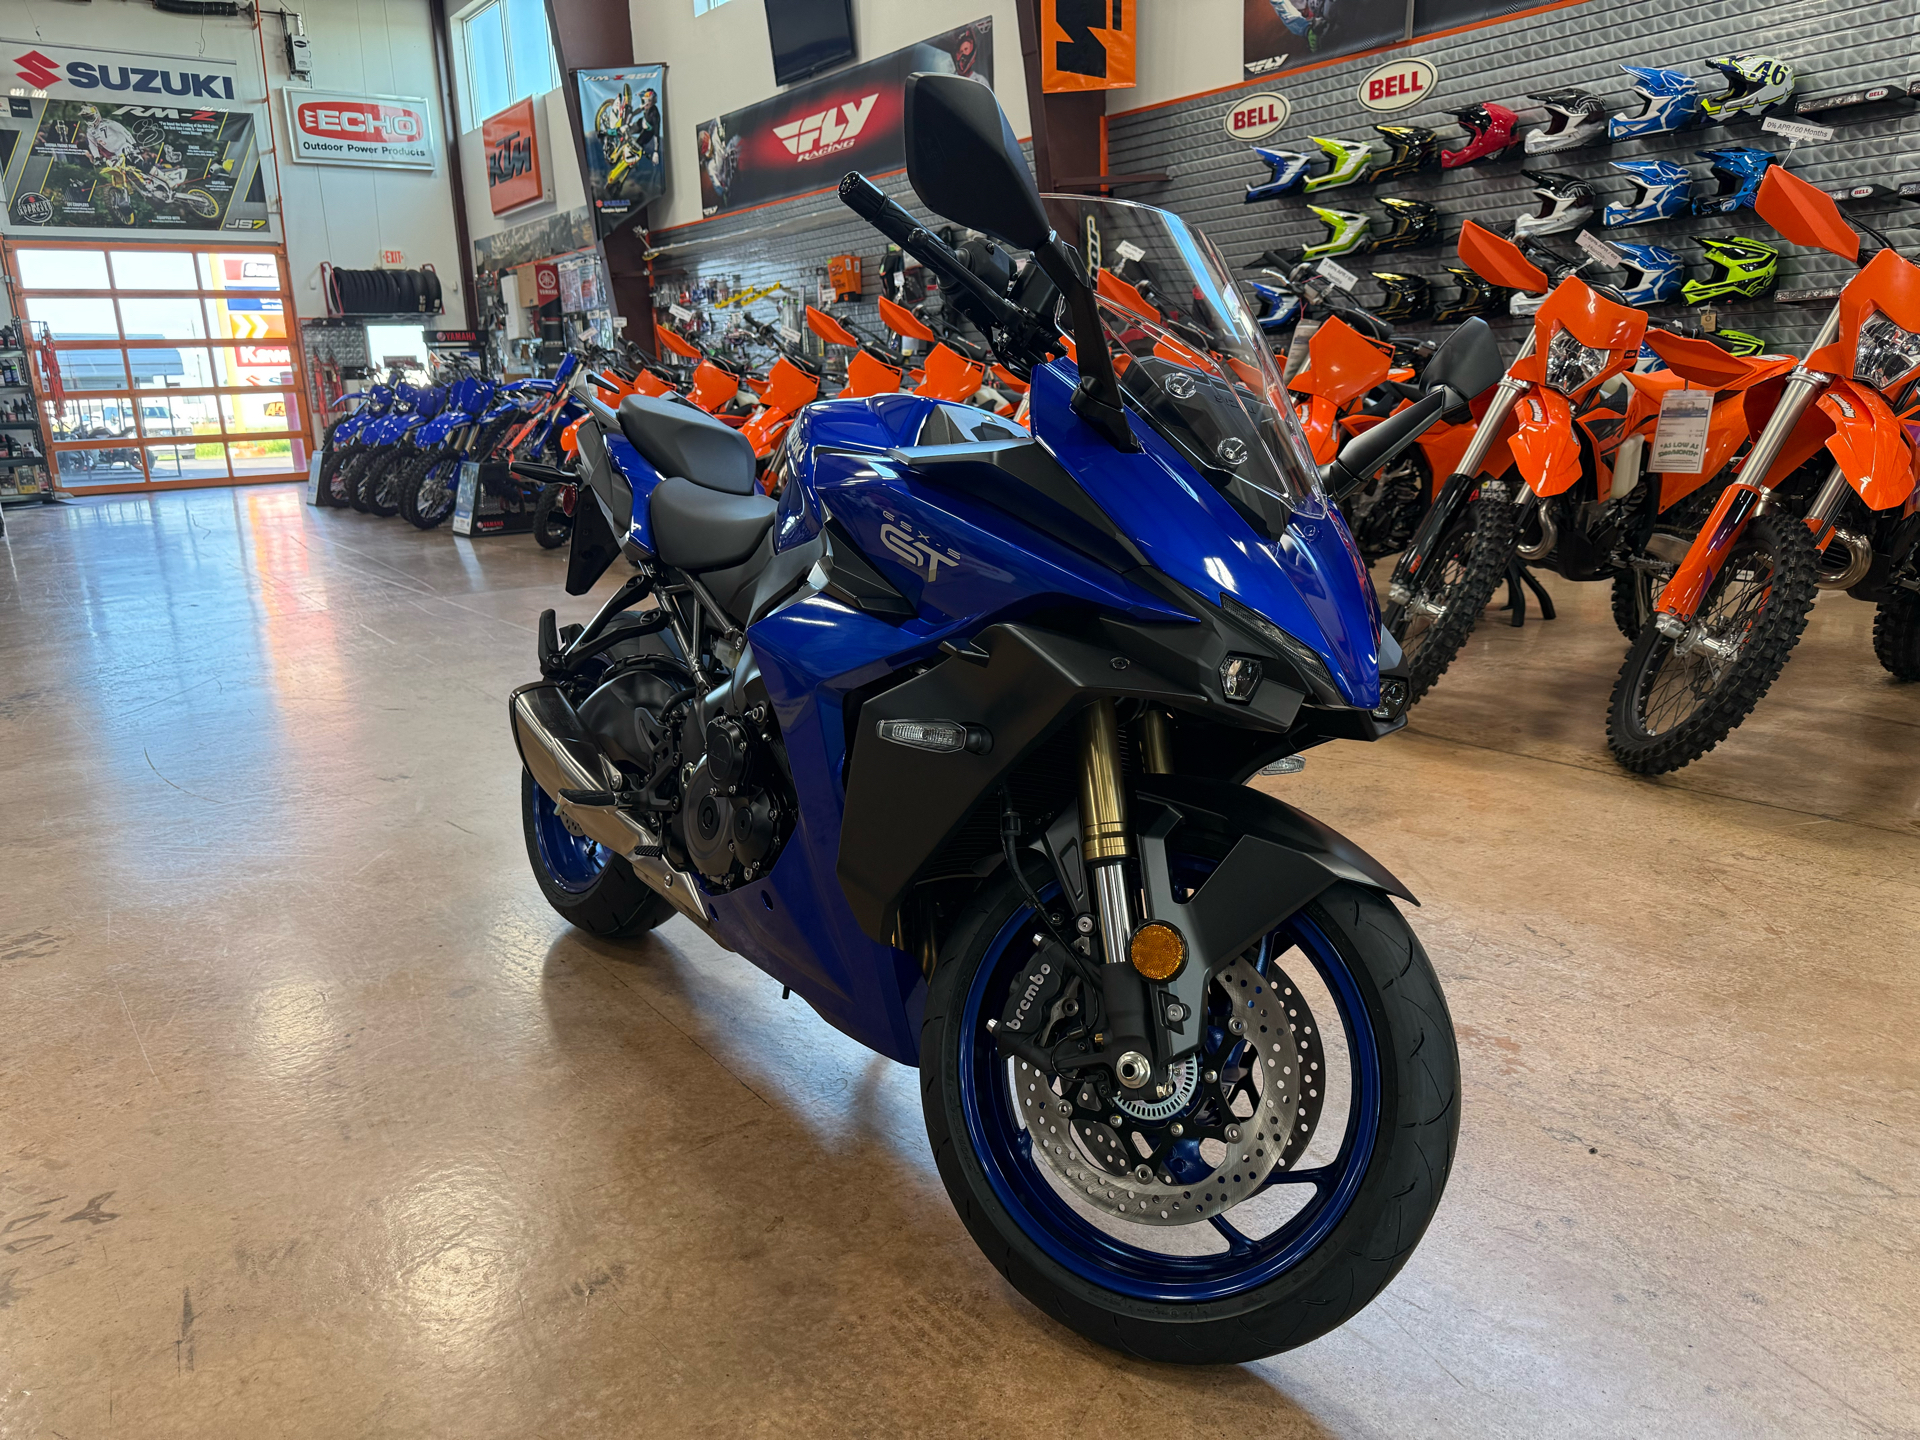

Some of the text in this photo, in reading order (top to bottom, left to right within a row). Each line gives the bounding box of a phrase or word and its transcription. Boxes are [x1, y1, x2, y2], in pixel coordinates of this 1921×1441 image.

[65, 61, 235, 100] SUZUKI
[1369, 71, 1423, 101] BELL
[112, 105, 217, 122] RM-Z
[316, 109, 418, 136] ECHO
[772, 92, 879, 155] FLY
[1233, 104, 1278, 130] BELL
[1766, 121, 1777, 129] 0%
[1777, 123, 1791, 132] APR
[1794, 125, 1804, 134] 60
[1803, 127, 1828, 138] Months
[303, 141, 425, 157] Outdoor Power Products
[489, 131, 532, 188] KTM
[225, 218, 266, 231] JS7
[385, 251, 402, 263] EXIT
[445, 332, 477, 341] YAMAHA
[1005, 963, 1051, 1030] brembo
